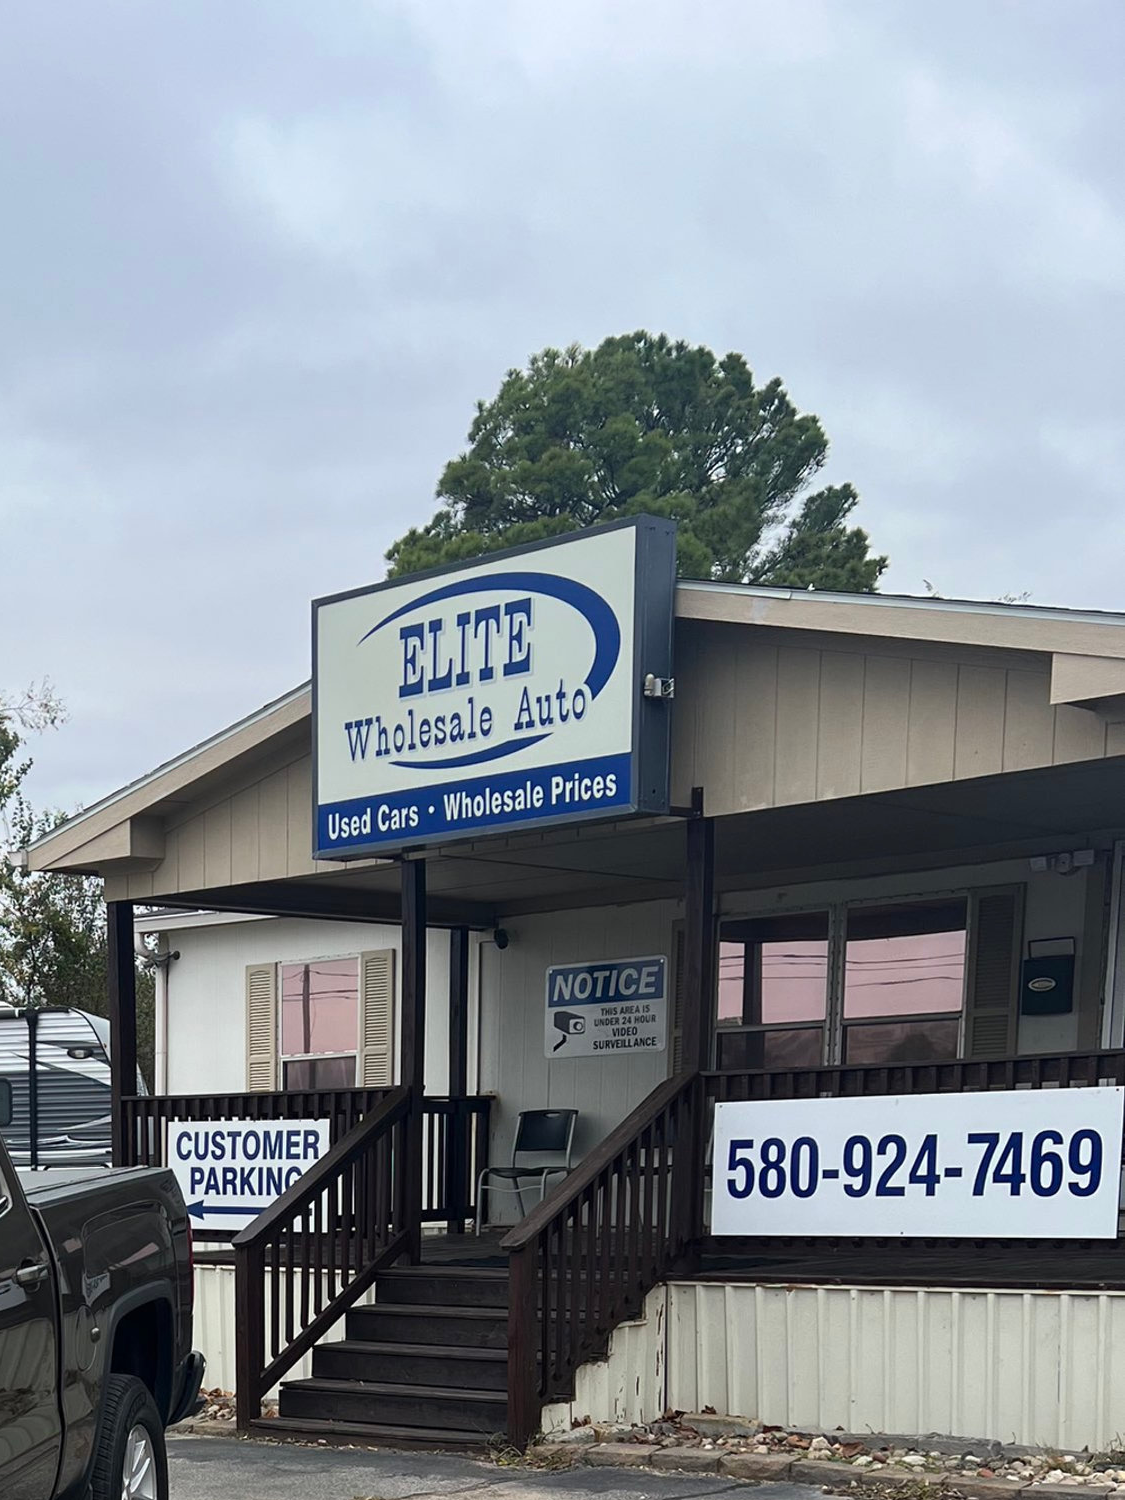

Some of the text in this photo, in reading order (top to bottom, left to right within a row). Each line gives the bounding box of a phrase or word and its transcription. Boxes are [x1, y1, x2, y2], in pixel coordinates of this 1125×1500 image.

[398, 597, 533, 698] ELITE
[344, 679, 586, 762] Wholesale Auto
[328, 773, 617, 840] Used Cars Wholesale Prices
[553, 966, 659, 1001] NOTICE
[594, 1014, 657, 1027] UNDER 24 HOUR
[600, 1004, 651, 1016] THIS AREA IS
[593, 1037, 657, 1050] SURVEILLANCE
[612, 1027, 638, 1037] VIDEO
[176, 1130, 320, 1161] CUSTOMER
[727, 1128, 1104, 1199] 580-924-7469
